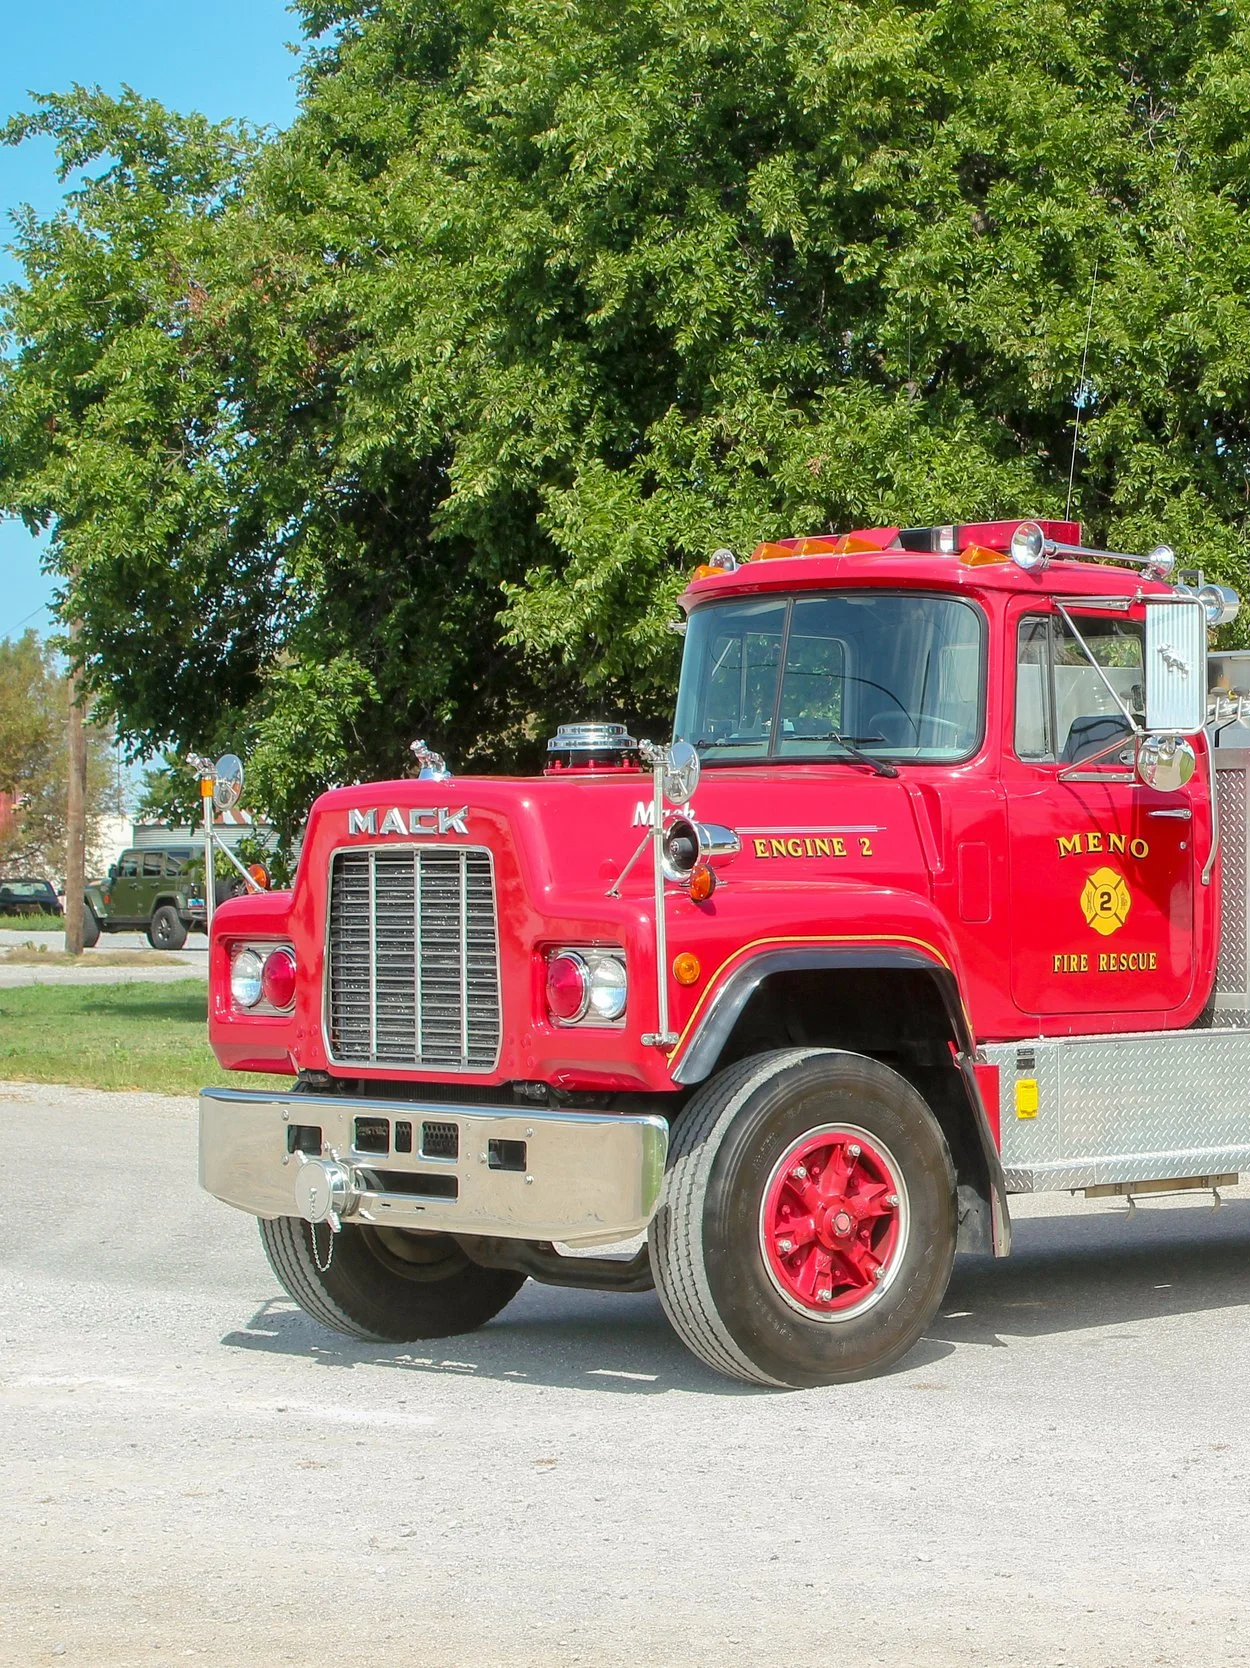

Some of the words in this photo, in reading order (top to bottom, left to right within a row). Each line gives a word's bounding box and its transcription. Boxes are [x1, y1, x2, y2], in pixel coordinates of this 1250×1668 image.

[348, 805, 470, 835] MACK
[753, 837, 847, 858] ENGINE
[858, 837, 873, 857] 2
[1056, 832, 1150, 858] MENO
[1099, 891, 1112, 911] 2
[1053, 954, 1089, 973] FIRE
[1098, 952, 1157, 972] RESCUE
